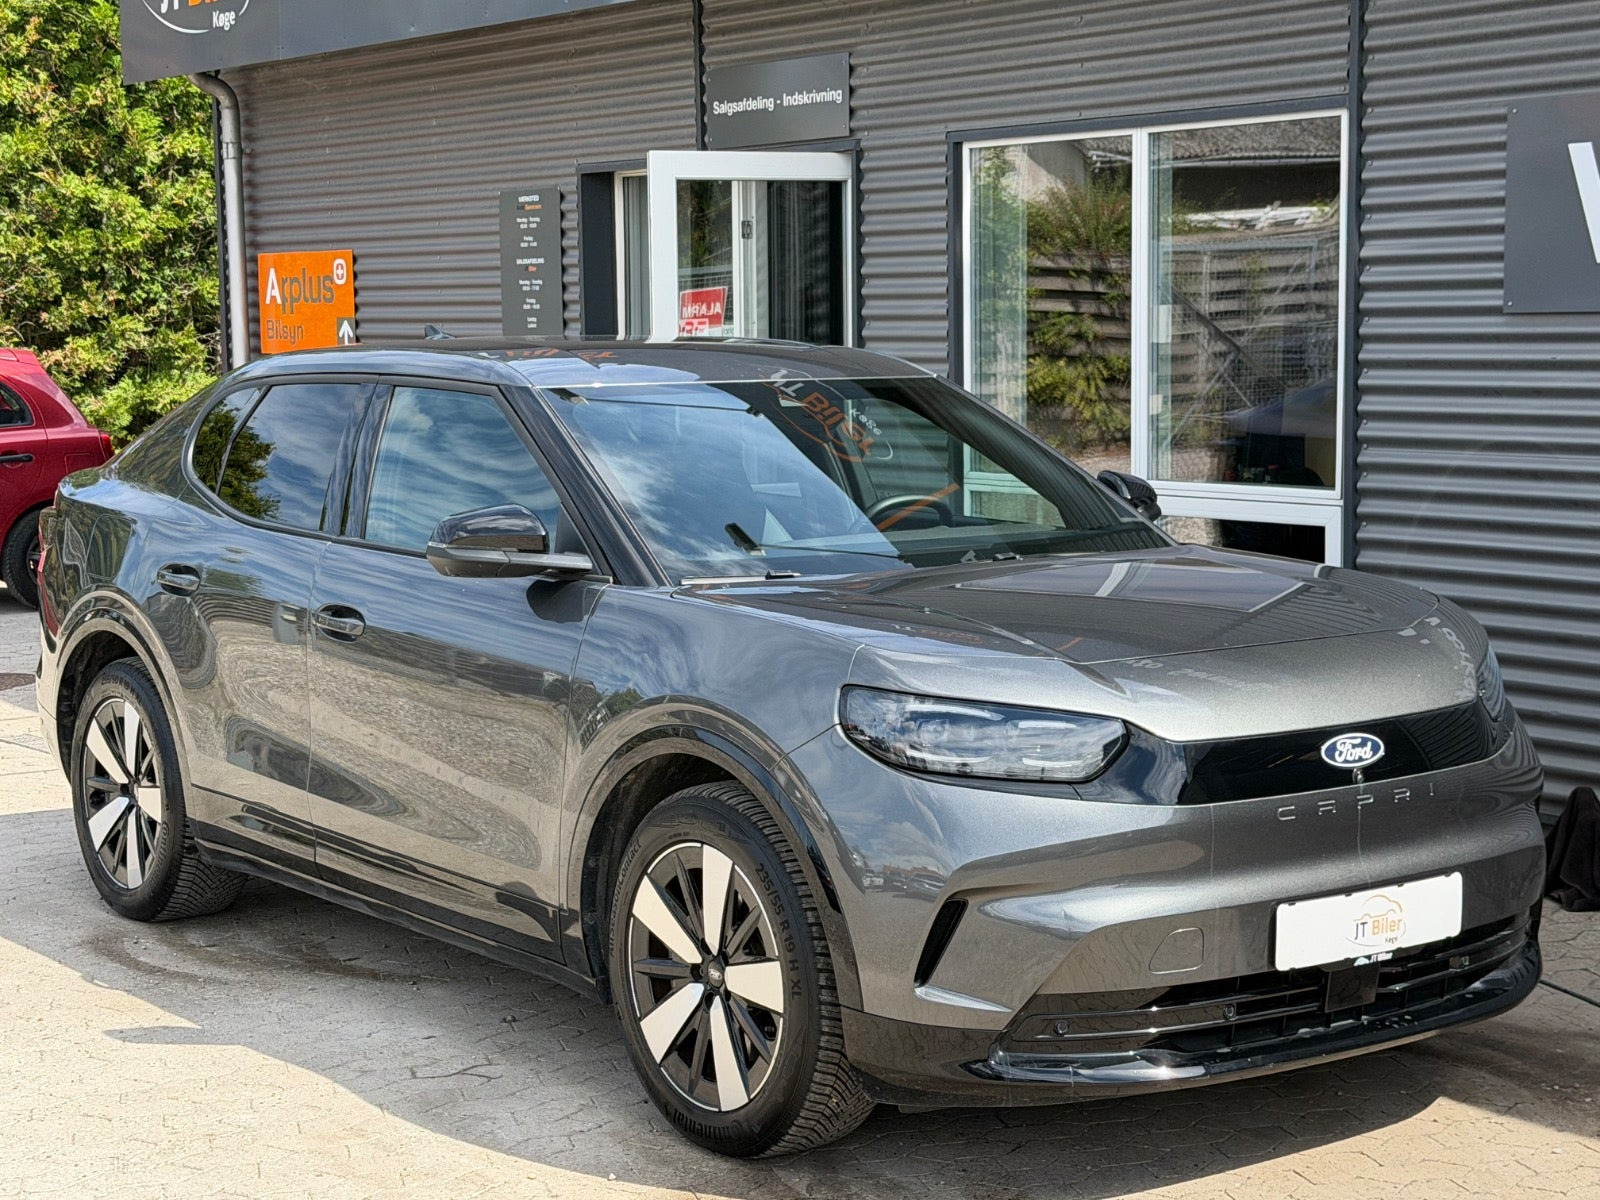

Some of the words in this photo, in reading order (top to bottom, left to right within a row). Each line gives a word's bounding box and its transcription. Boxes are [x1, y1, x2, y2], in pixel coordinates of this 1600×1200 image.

[212, 10, 236, 31] Køge
[713, 96, 774, 116] Salgsafdeling
[782, 87, 843, 107] Indskrivning
[266, 319, 304, 345] Bilsyn
[1334, 738, 1373, 763] Ford
[1277, 782, 1434, 820] CAPRI
[755, 862, 785, 916] 235/55
[780, 920, 790, 934] R
[1354, 921, 1368, 941] JT
[1371, 916, 1402, 936] Biler
[784, 934, 796, 954] 19
[791, 979, 802, 1001] XL
